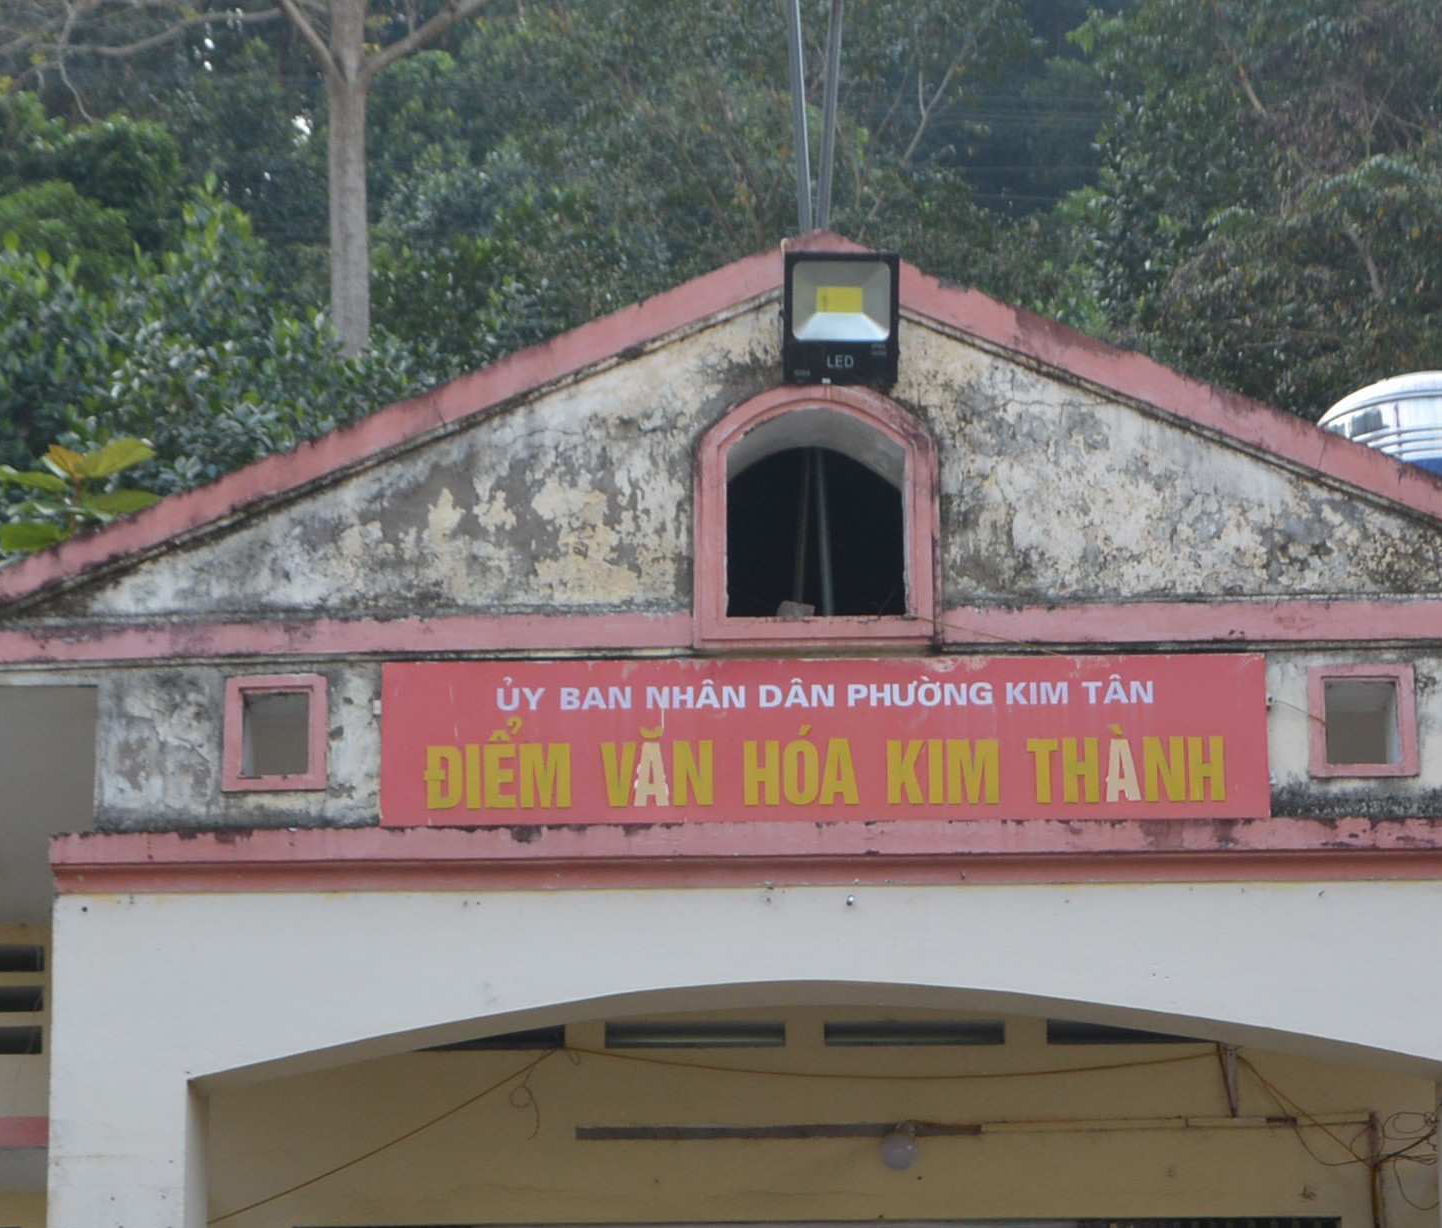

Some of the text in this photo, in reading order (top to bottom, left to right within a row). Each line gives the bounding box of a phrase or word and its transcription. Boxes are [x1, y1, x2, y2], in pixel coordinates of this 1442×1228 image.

[827, 355, 854, 368] LED
[496, 674, 1154, 711] ỦY BAN NHÂN DÂN PHƯỜNG KIM TÂN
[424, 716, 1226, 810] ĐIỂM VĂN HÓA KIM THÀNH
